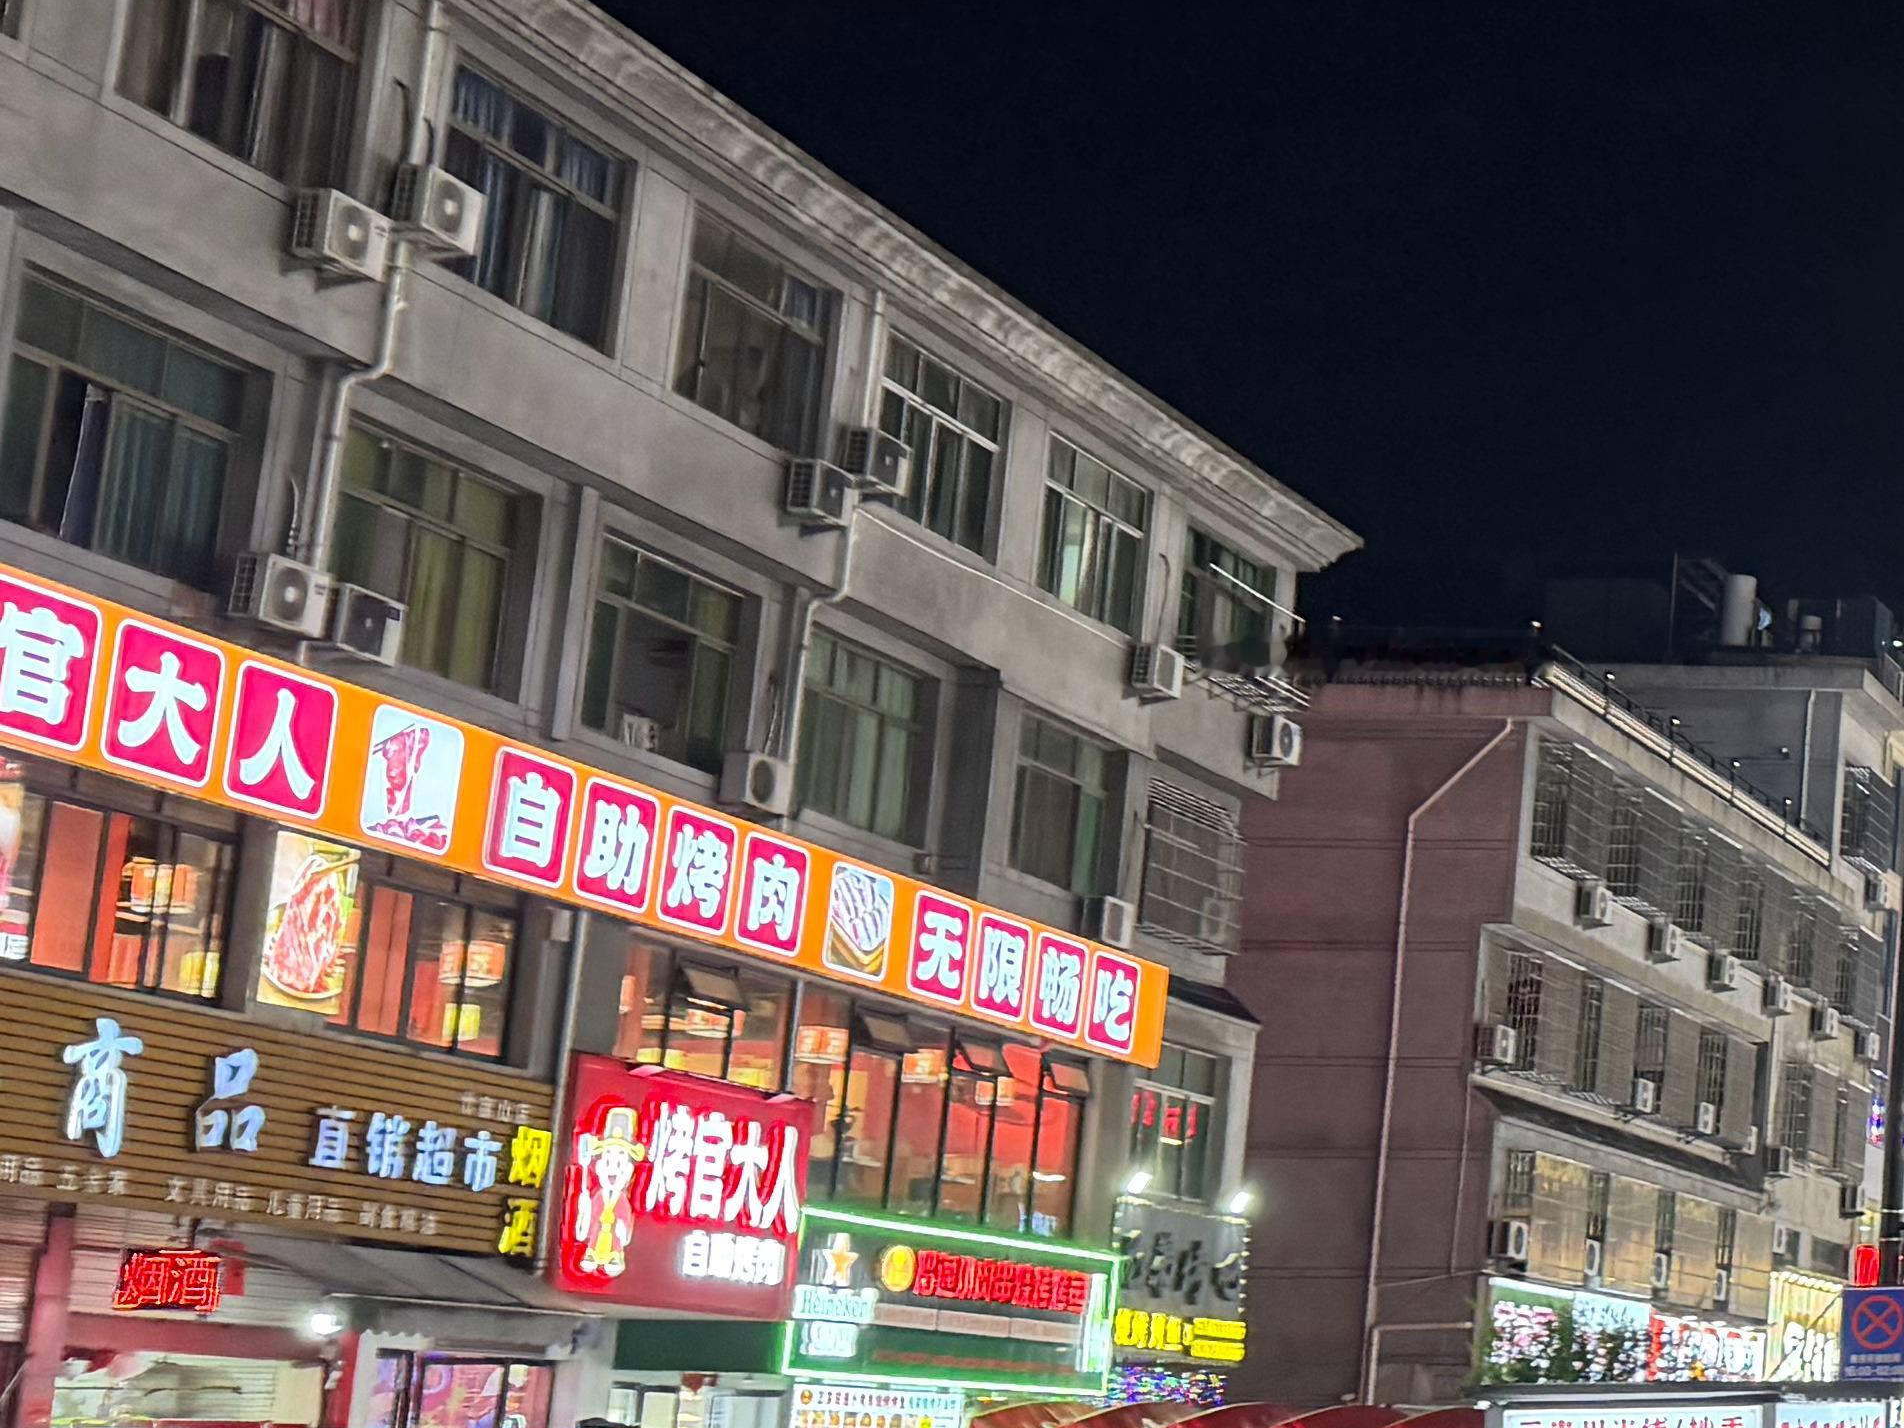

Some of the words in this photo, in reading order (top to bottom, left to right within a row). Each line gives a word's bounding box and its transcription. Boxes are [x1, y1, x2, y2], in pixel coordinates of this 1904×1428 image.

[0, 607, 316, 801] 官大人
[504, 771, 804, 939] 自助烤肉
[916, 912, 1133, 1043] 无限畅吃
[64, 1018, 266, 1158] 商品
[308, 1105, 502, 1192] 直销超市
[646, 1101, 799, 1234] 烤官大人
[498, 1125, 552, 1257] 烟酒
[801, 1288, 870, 1318] Heineken
